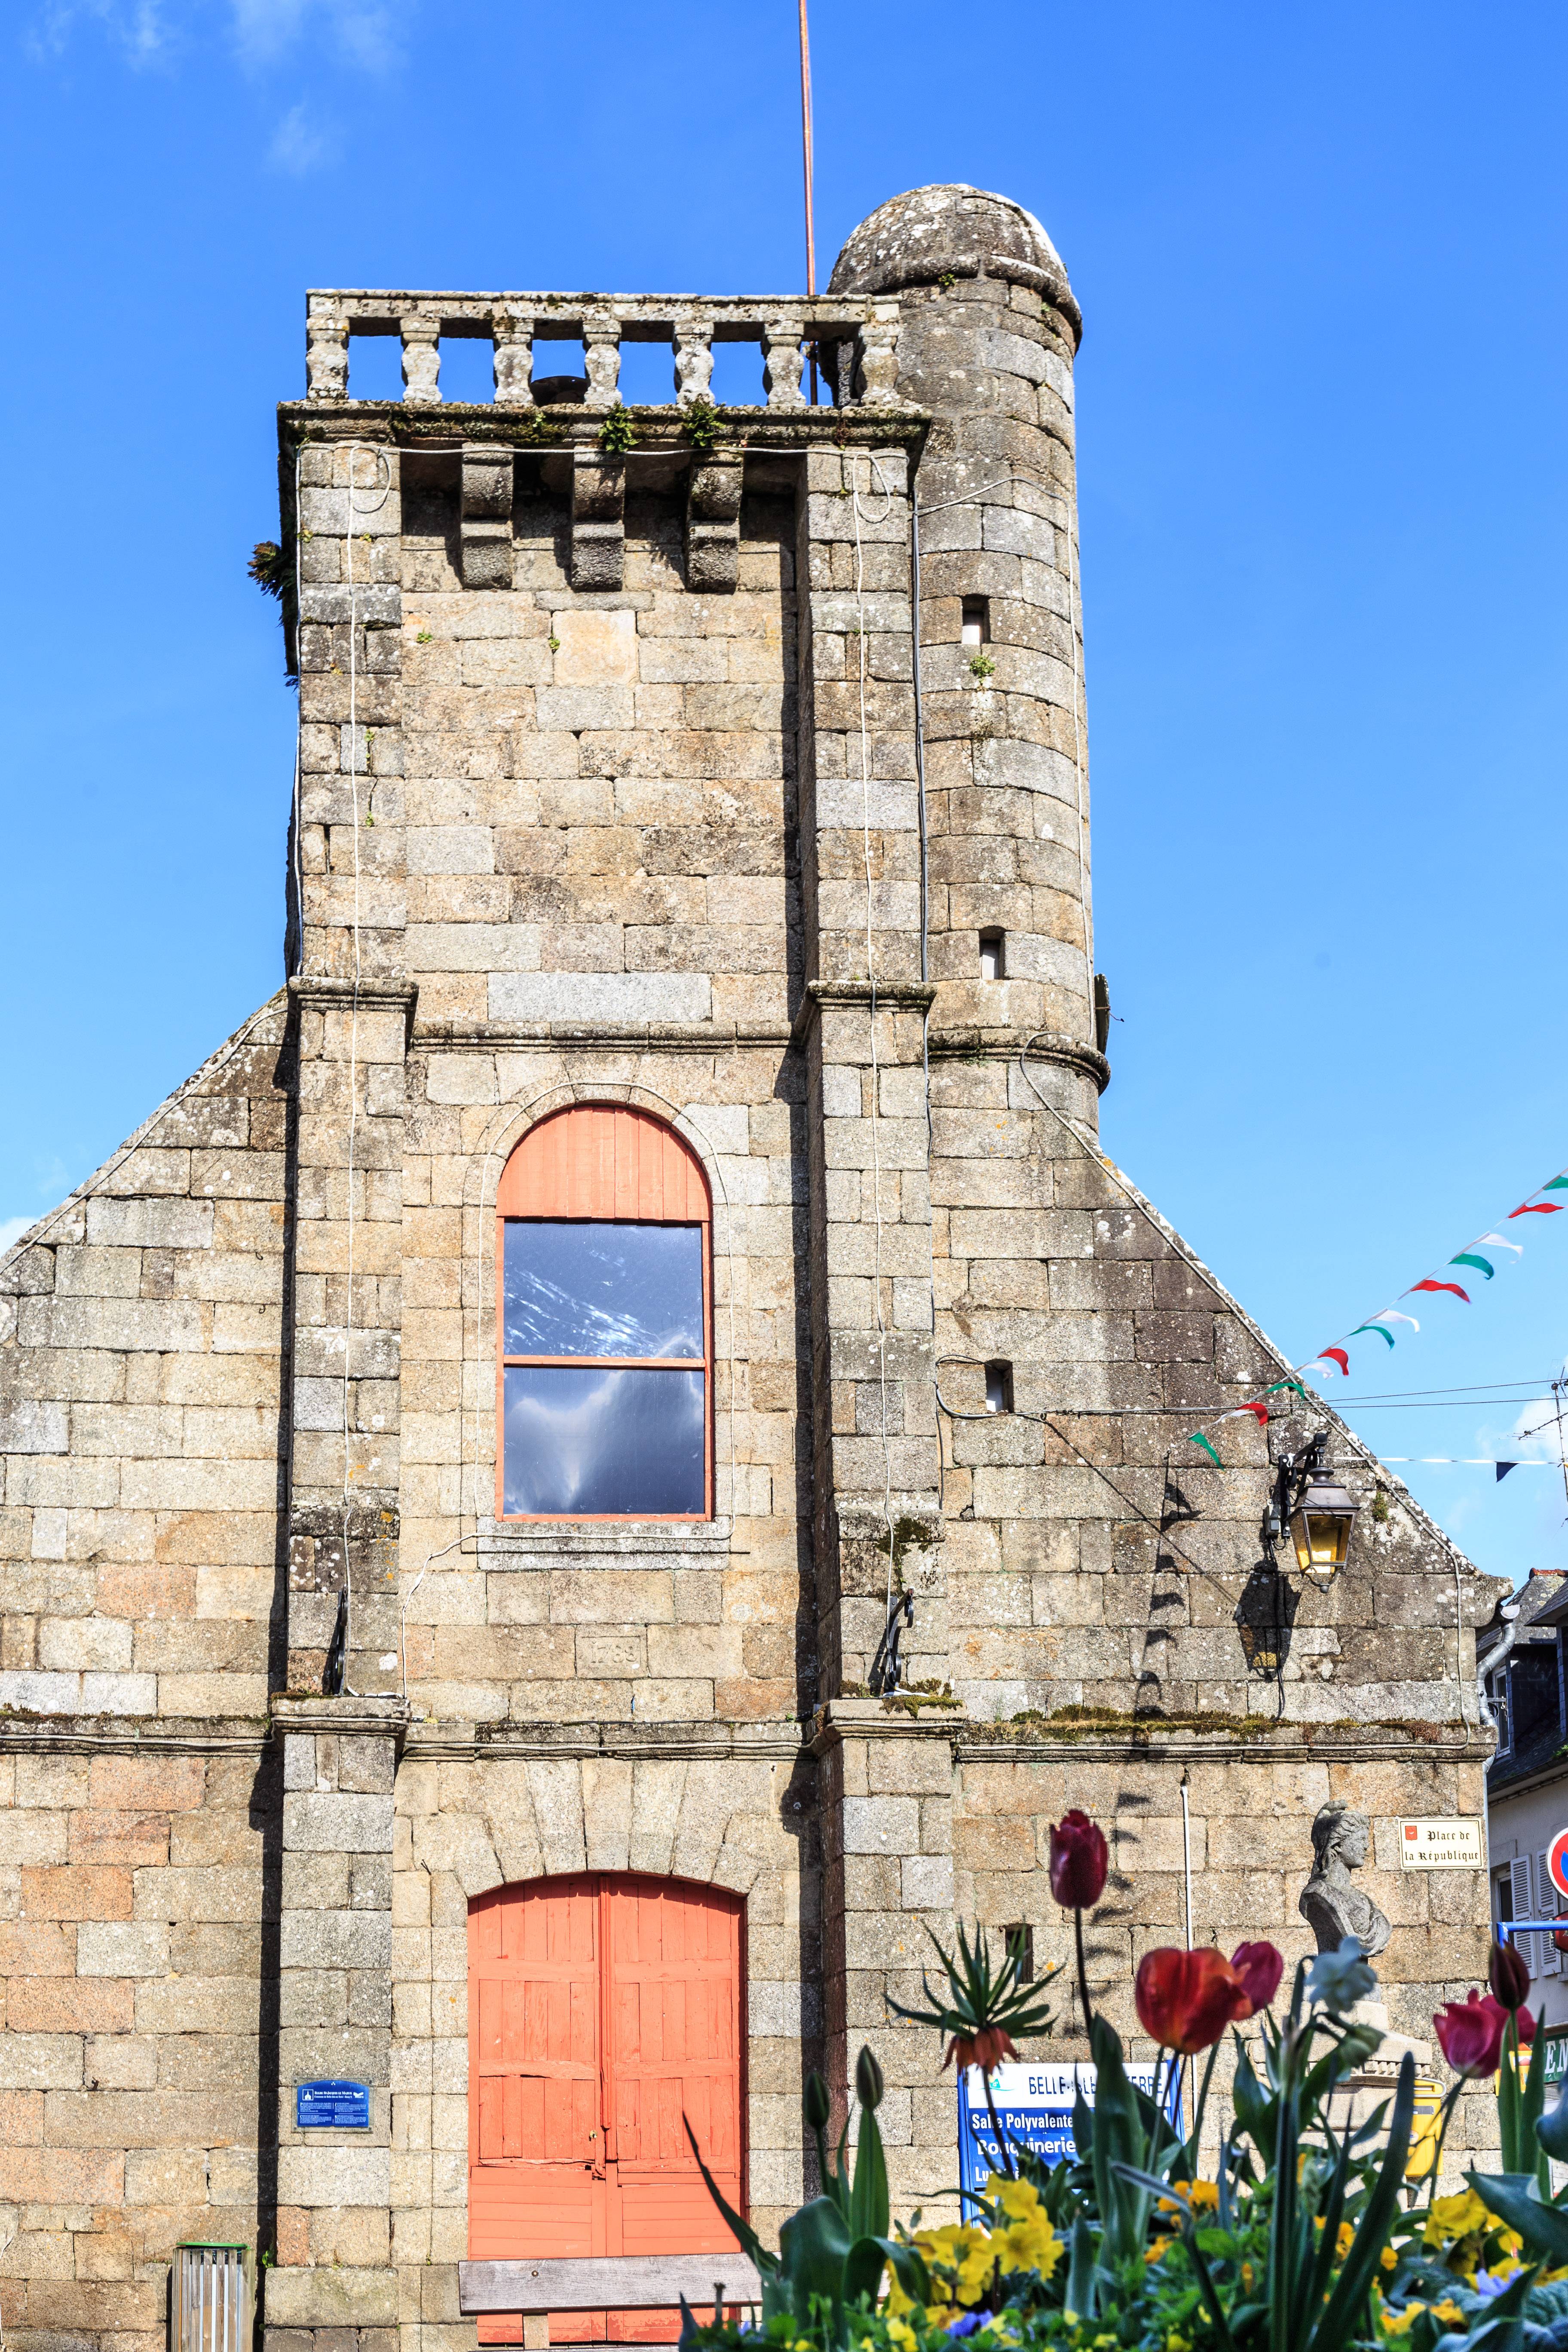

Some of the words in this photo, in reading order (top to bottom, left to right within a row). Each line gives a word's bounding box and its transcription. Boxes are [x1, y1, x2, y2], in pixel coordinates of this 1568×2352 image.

[1427, 1831, 1456, 1841] Place
[1460, 1831, 1470, 1840] de
[1405, 1852, 1414, 1860] la
[1418, 1850, 1479, 1862] République
[1006, 2113, 1073, 2132] Polyvalente
